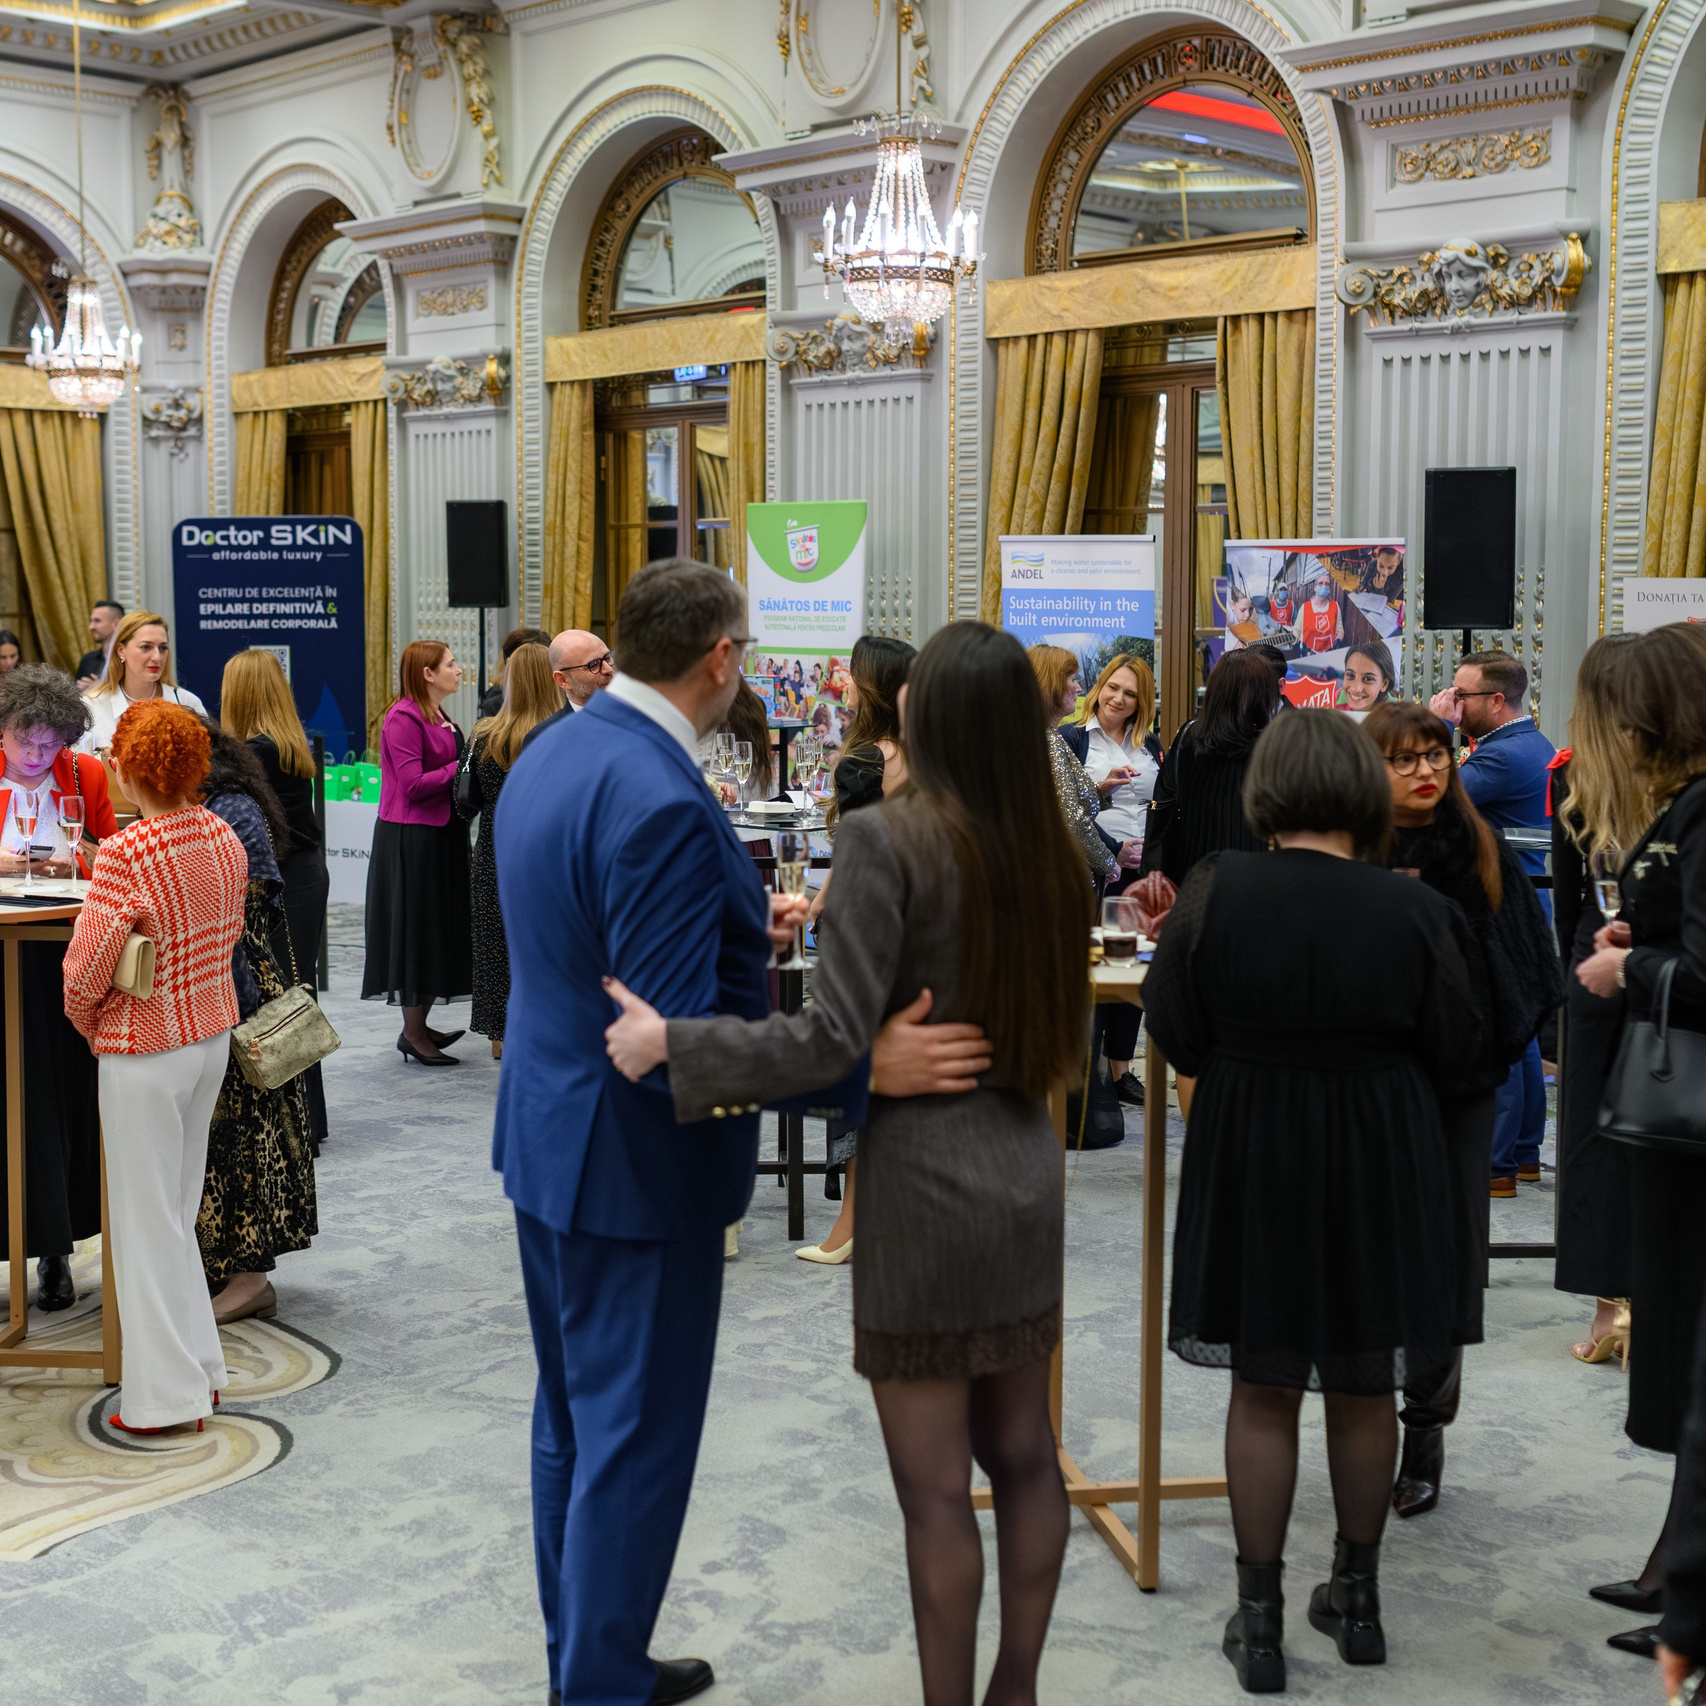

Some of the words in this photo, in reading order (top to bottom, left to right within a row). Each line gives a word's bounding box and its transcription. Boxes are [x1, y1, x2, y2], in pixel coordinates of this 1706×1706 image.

[181, 524, 264, 546] Doctor
[270, 524, 352, 546] SKiN
[212, 550, 279, 560] affordable
[282, 550, 323, 562] luxury
[1050, 559, 1072, 567] Making
[1010, 568, 1044, 580] ANDEL
[198, 587, 243, 599] CENTRU
[245, 587, 260, 598] DE
[199, 603, 250, 615] EPILARE
[252, 600, 325, 615] DEFINITIVĂ
[326, 602, 338, 614] &
[759, 597, 811, 612] SĂNĂTOS
[813, 600, 828, 612] DE
[831, 600, 852, 612] MIC
[1009, 596, 1097, 614] Sustainability
[1100, 597, 1112, 611] in
[1116, 597, 1139, 611] the
[200, 619, 270, 630] REMODELARE
[271, 617, 338, 629] CORPORALĂ
[1009, 612, 1038, 626] built
[1041, 613, 1125, 628] environment
